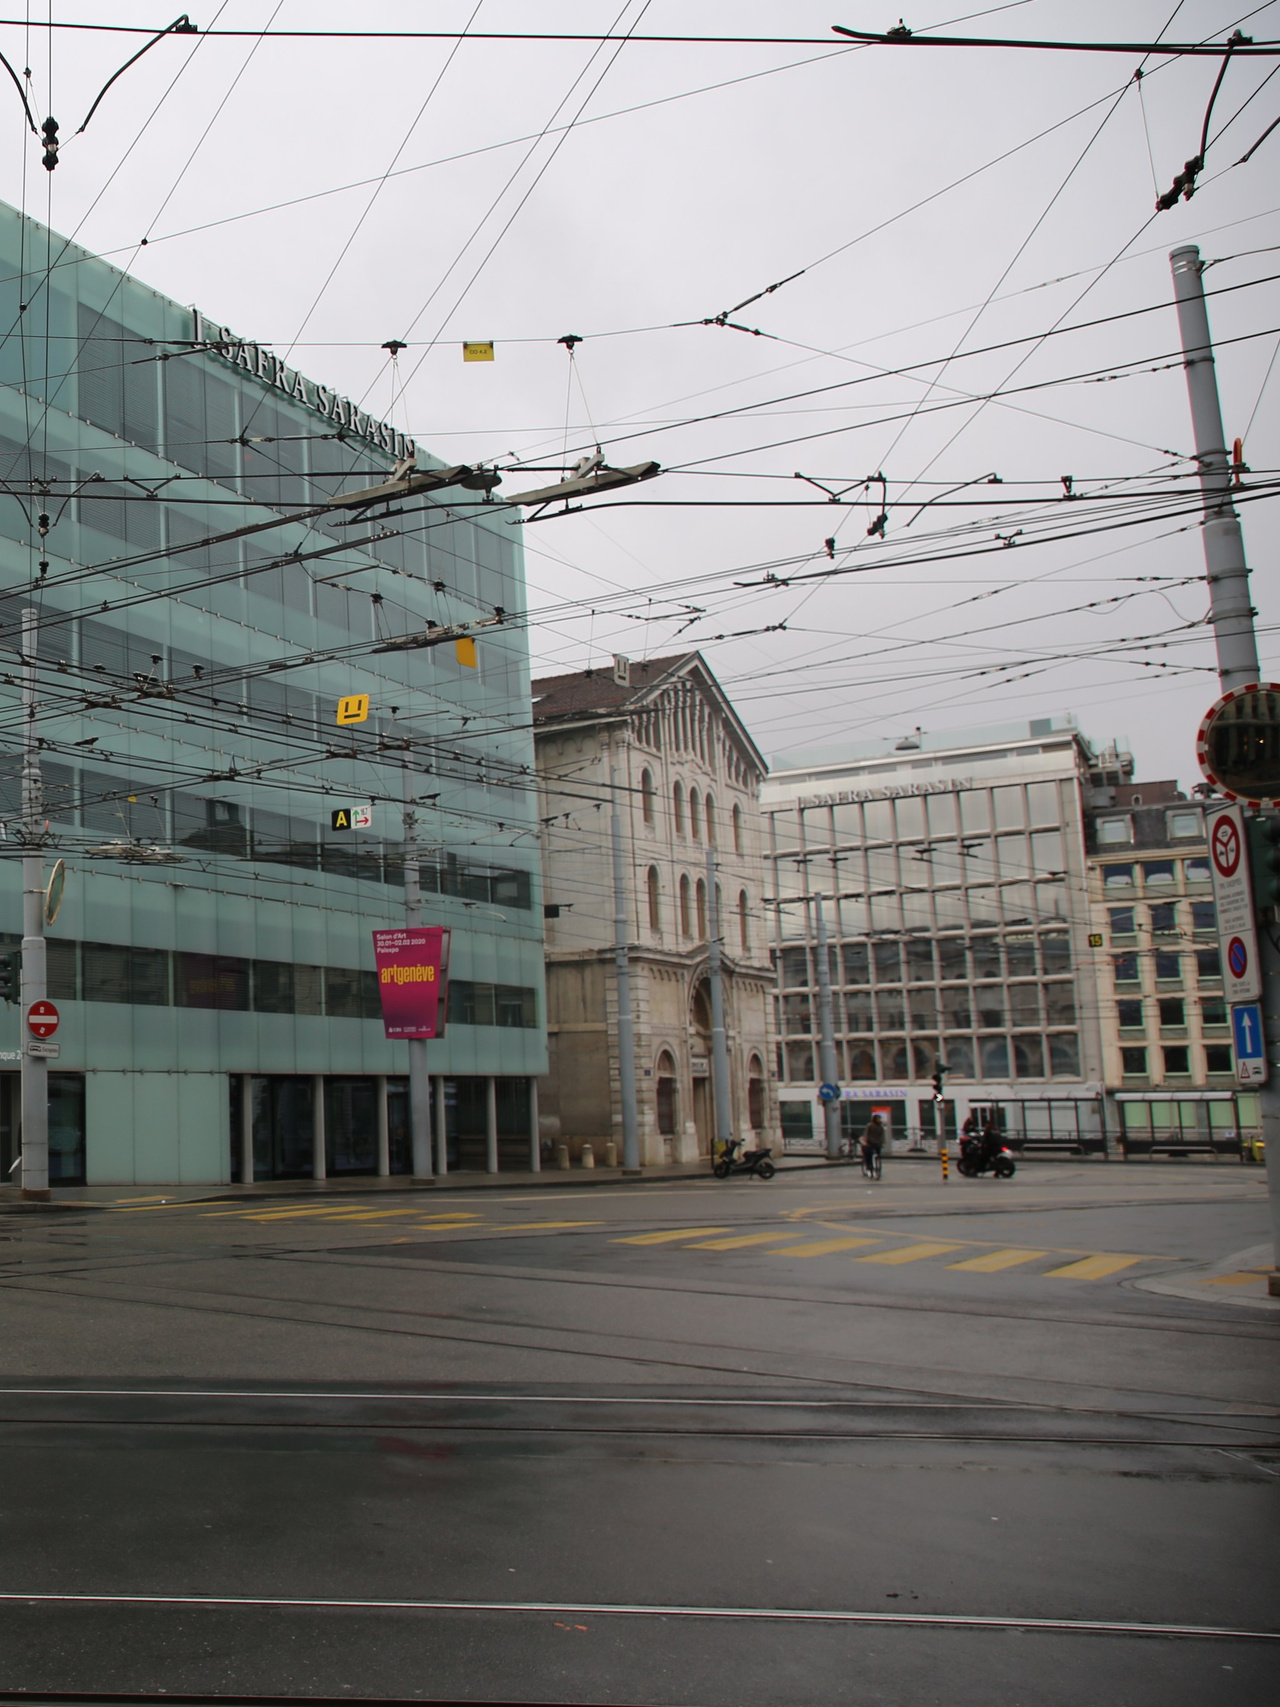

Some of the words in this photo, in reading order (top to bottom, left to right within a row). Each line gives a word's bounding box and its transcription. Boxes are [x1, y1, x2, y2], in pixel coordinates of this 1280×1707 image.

[219, 325, 309, 402] SAFRA
[316, 382, 416, 461] SARASIN
[810, 788, 873, 807] SAFRA
[881, 776, 973, 799] SARASIN
[336, 811, 347, 827] A
[376, 933, 393, 941] Salon
[393, 932, 407, 940] d'Art
[411, 938, 426, 946] 2020
[1090, 935, 1101, 946] 15
[381, 963, 435, 986] artgenève
[862, 1089, 908, 1098] SARASIN
